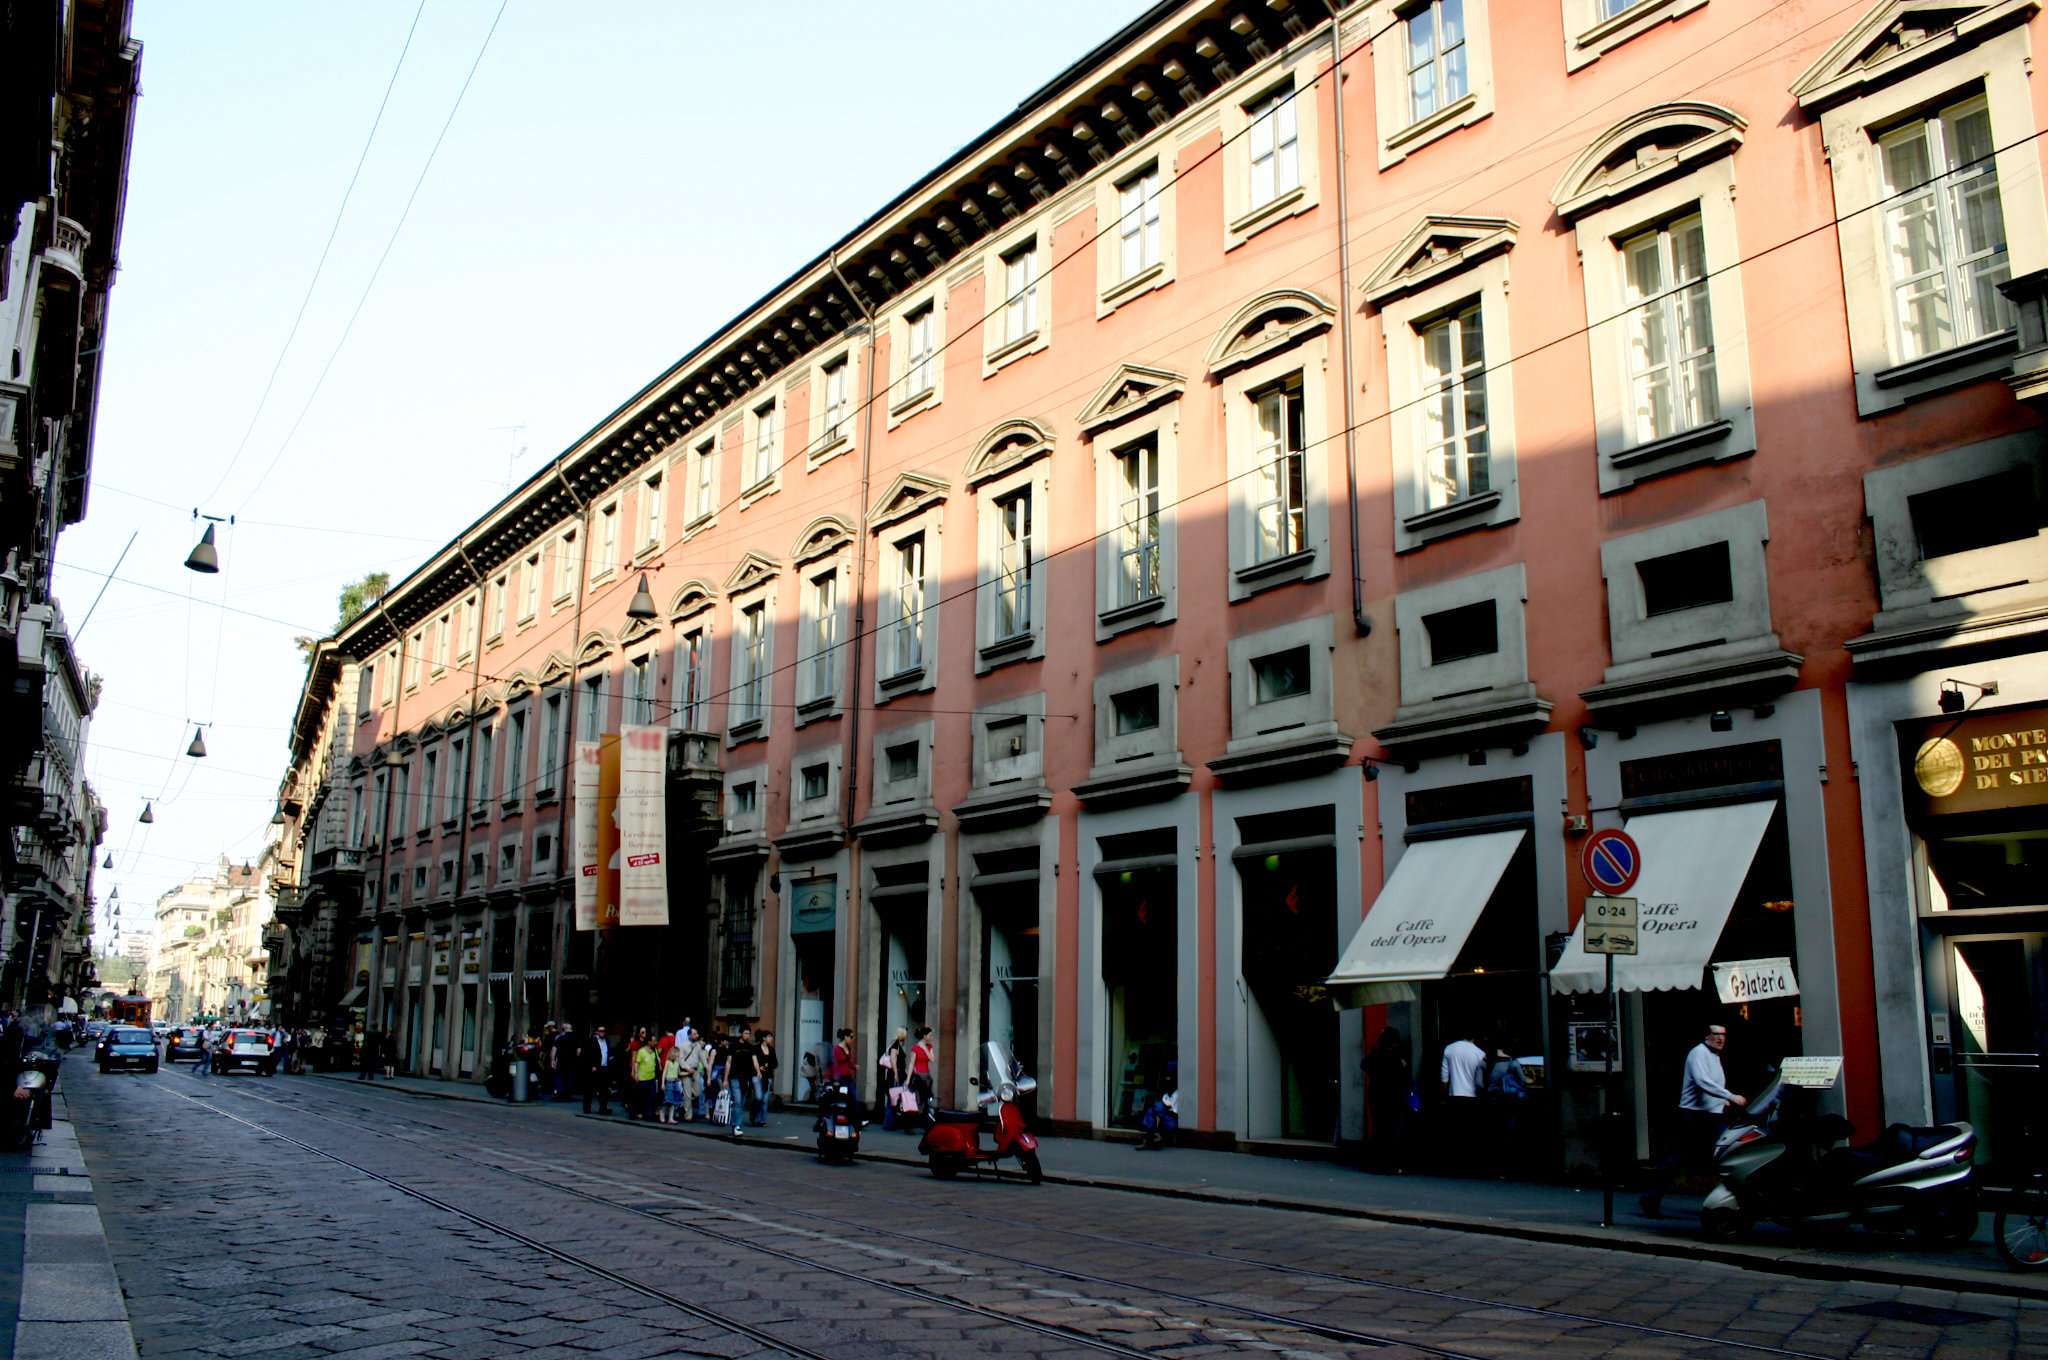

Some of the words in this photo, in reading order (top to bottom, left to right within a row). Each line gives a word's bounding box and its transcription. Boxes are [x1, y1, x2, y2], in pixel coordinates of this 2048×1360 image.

[1971, 729, 2047, 753] MONTE
[1973, 752, 2011, 771] DEI
[1975, 773, 1999, 790] DI
[1598, 905, 1626, 917] 0-24
[1639, 903, 1680, 916] affè
[1396, 919, 1434, 932] Caffè
[1730, 969, 1785, 998] Gelateria
